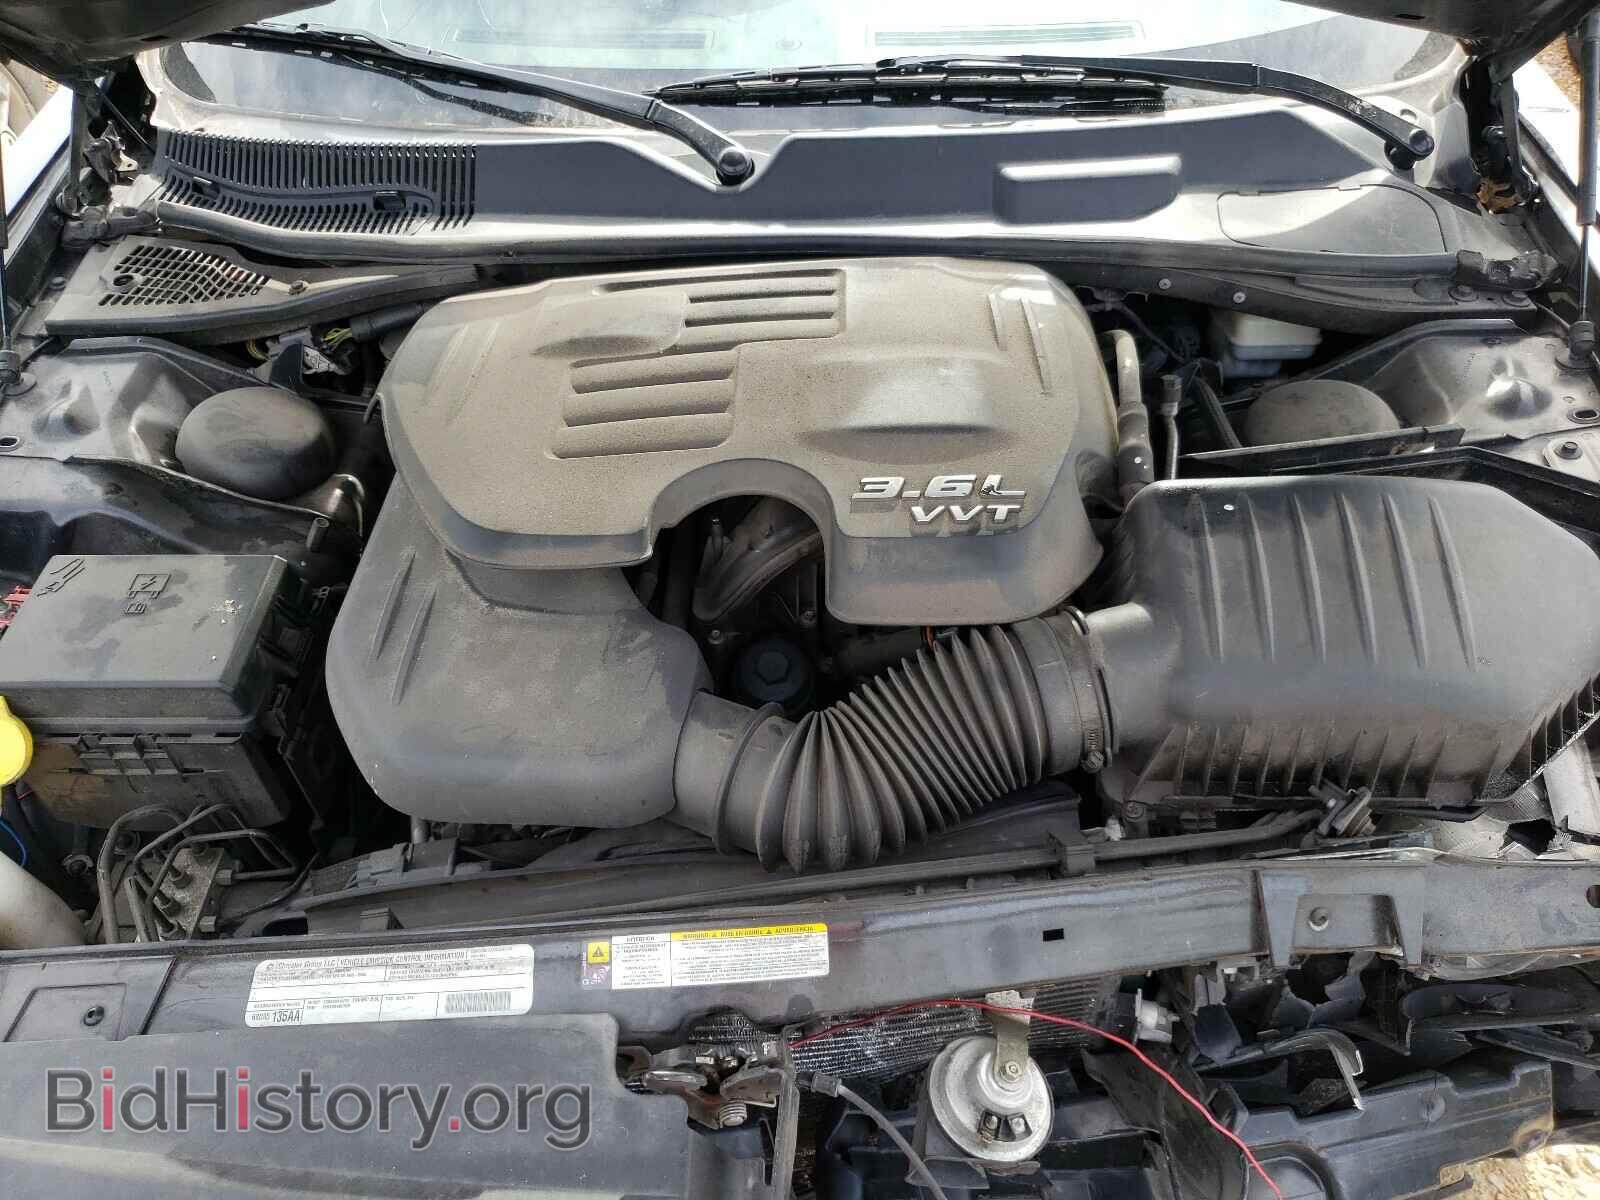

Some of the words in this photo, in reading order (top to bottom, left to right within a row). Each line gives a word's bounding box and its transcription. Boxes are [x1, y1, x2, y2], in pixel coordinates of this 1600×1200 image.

[852, 474, 1025, 498] 3.6L
[910, 504, 1020, 523] VVT
[273, 1010, 300, 1022] 135AA
